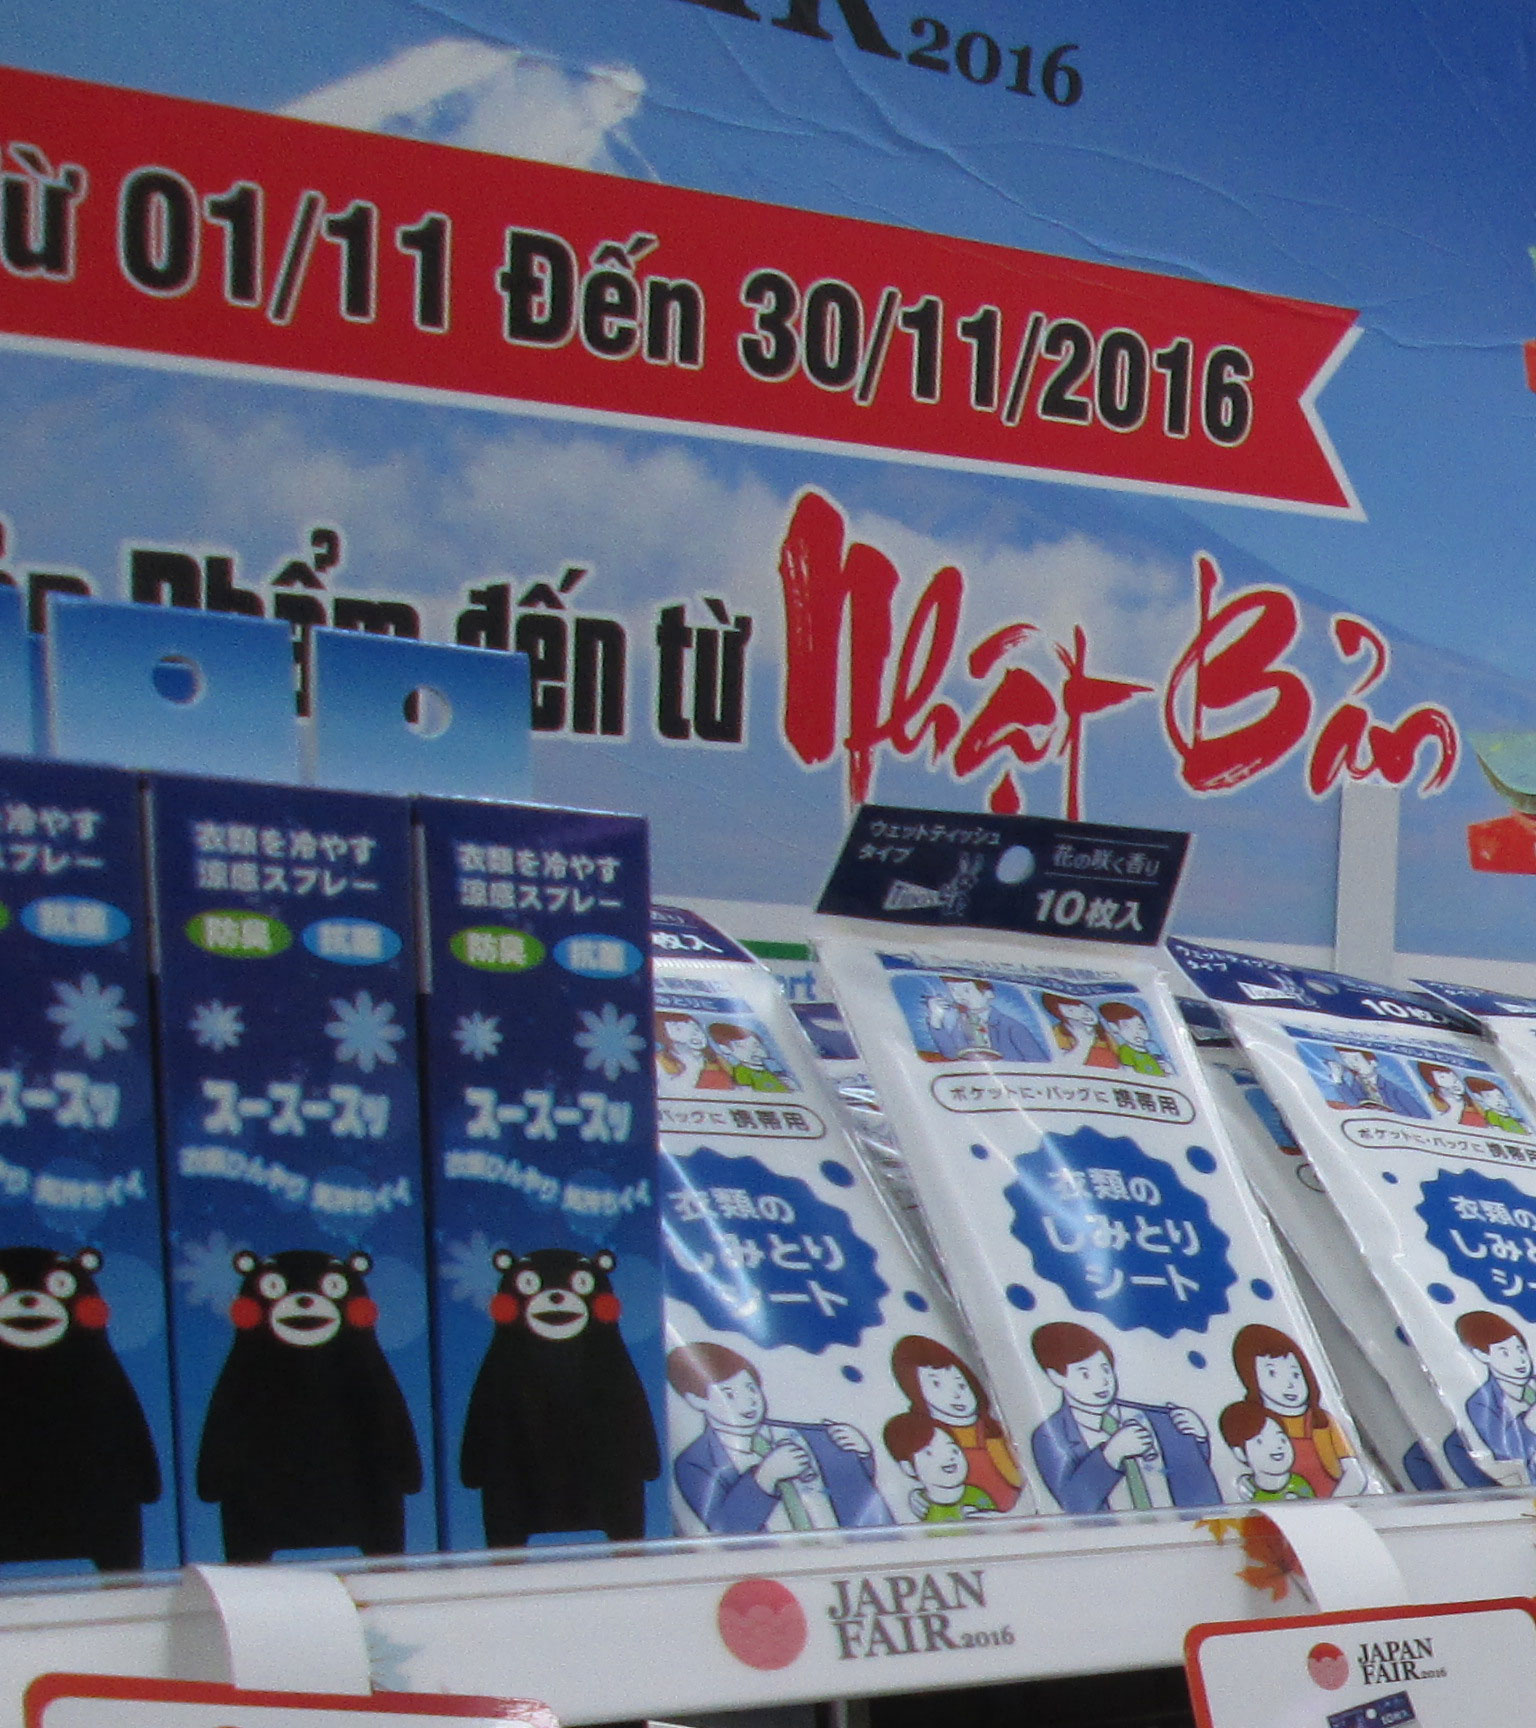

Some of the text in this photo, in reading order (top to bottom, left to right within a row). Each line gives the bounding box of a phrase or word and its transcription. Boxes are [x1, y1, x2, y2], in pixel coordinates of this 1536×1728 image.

[908, 18, 1084, 108] 2016
[0, 143, 1255, 446] ừ 01/11 Đến 30/11/2016
[656, 597, 753, 743] từ
[778, 485, 1155, 820] Nhật
[1161, 552, 1460, 797] Bản
[195, 823, 377, 865] 衣類を冷やす
[455, 843, 621, 884] 衣類を冷やす
[858, 843, 915, 864] タイプ
[1035, 889, 1144, 932] 10枚入
[1042, 1212, 1200, 1254] しみとり
[1085, 1260, 1202, 1303] シート
[828, 1569, 988, 1621] JAPAN
[834, 1613, 1015, 1661] FAIR 2016
[1357, 1637, 1434, 1667] JAPAN
[1362, 1659, 1421, 1686] FAIR
